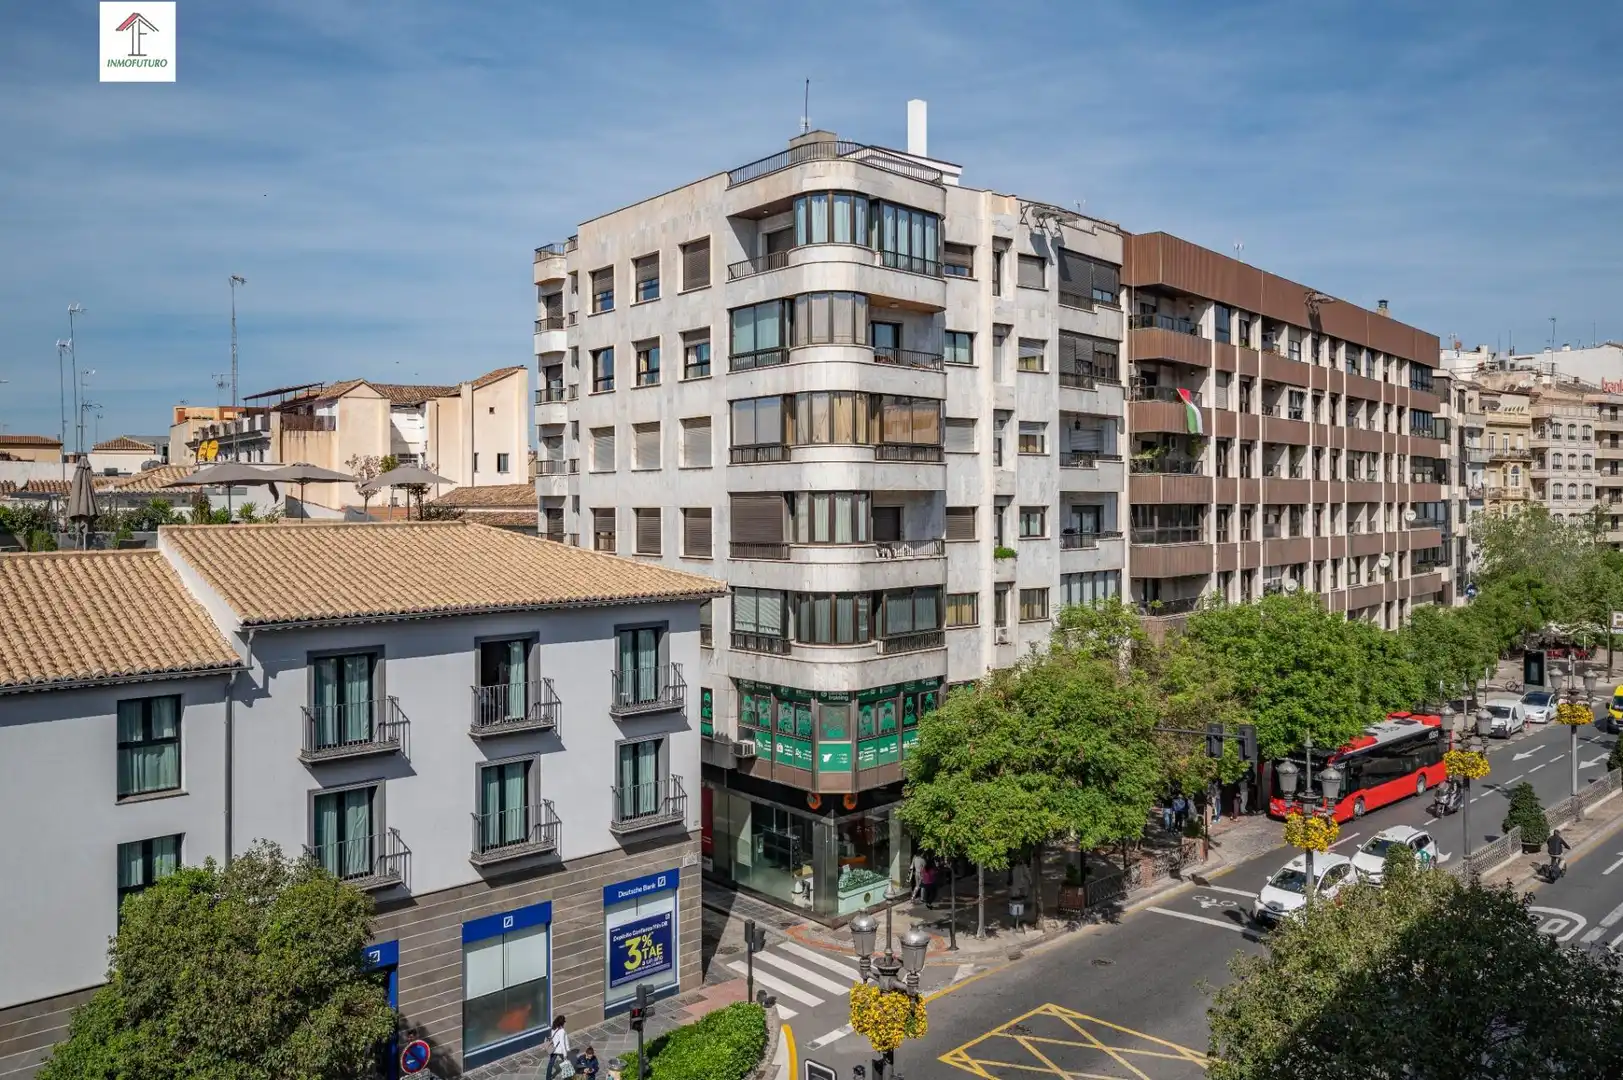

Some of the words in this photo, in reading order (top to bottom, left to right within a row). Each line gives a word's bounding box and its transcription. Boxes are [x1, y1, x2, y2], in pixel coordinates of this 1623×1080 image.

[617, 886, 642, 898] Deutsche
[642, 882, 656, 891] Bank
[624, 936, 642, 970] 3
[641, 943, 663, 960] TAE
